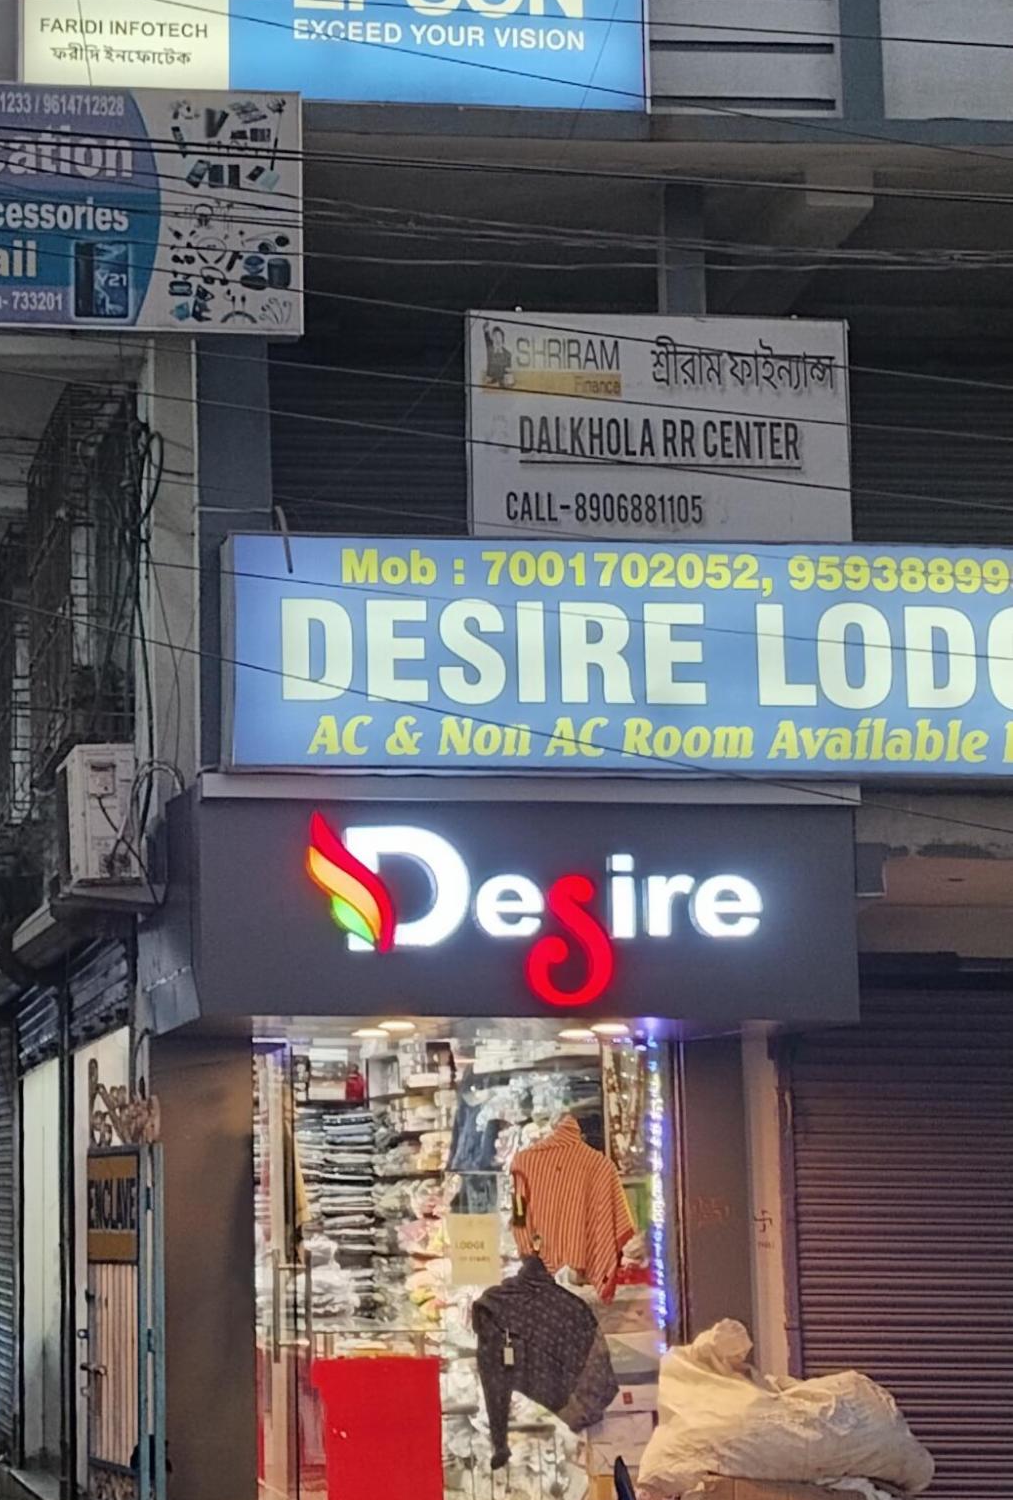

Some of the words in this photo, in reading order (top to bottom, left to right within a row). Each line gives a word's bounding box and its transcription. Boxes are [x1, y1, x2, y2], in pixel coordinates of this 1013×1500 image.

[40, 17, 103, 35] FARIDI
[109, 20, 208, 38] INFOTECH
[293, 19, 402, 46] EXCEED
[409, 23, 486, 49] YOUR
[494, 26, 585, 51] VISION
[103, 44, 192, 65] ইনফোটেক
[43, 91, 125, 116] 9614712828
[12, 292, 64, 312] 733201
[515, 336, 621, 371] SHRIRAM
[651, 335, 724, 387] শ্রীরাম
[574, 375, 622, 395] Finance
[518, 414, 655, 458] DALKHOLA
[663, 418, 696, 460] RR
[703, 420, 801, 461] CENTER
[341, 548, 437, 585] Mob
[452, 558, 466, 586] :
[481, 550, 774, 597] 7001702052,
[788, 554, 1013, 595] 95938899
[281, 598, 708, 705] DESIRE
[307, 715, 373, 756] AC
[385, 715, 424, 756] &
[437, 716, 531, 757] Non
[544, 717, 610, 757] AC
[621, 717, 754, 758] Room
[767, 717, 989, 763] Available
[341, 824, 764, 1006] Desire
